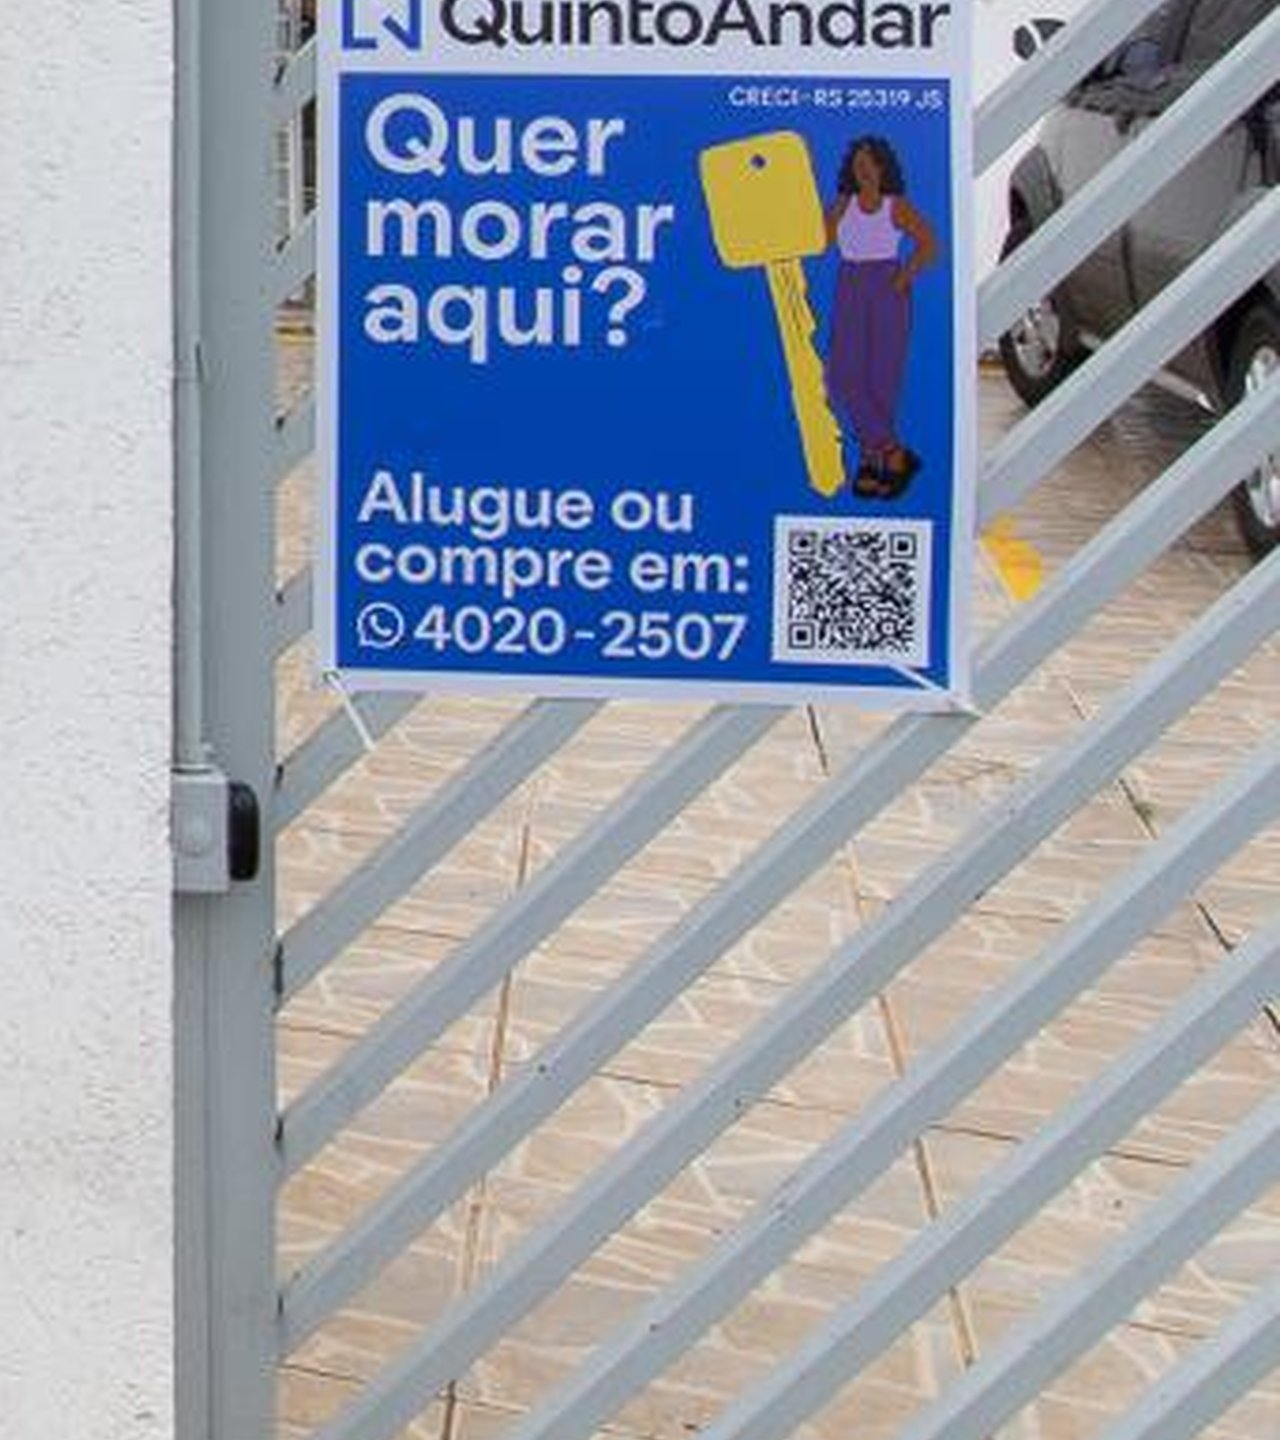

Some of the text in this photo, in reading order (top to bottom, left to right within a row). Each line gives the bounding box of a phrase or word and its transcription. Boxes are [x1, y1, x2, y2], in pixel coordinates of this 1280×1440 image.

[365, 92, 626, 177] Quer
[366, 198, 675, 262] morar
[363, 264, 647, 364] aqui?
[358, 470, 693, 541] Alugue ou
[355, 543, 749, 600] compre em:
[413, 605, 747, 661] 4020-2507
